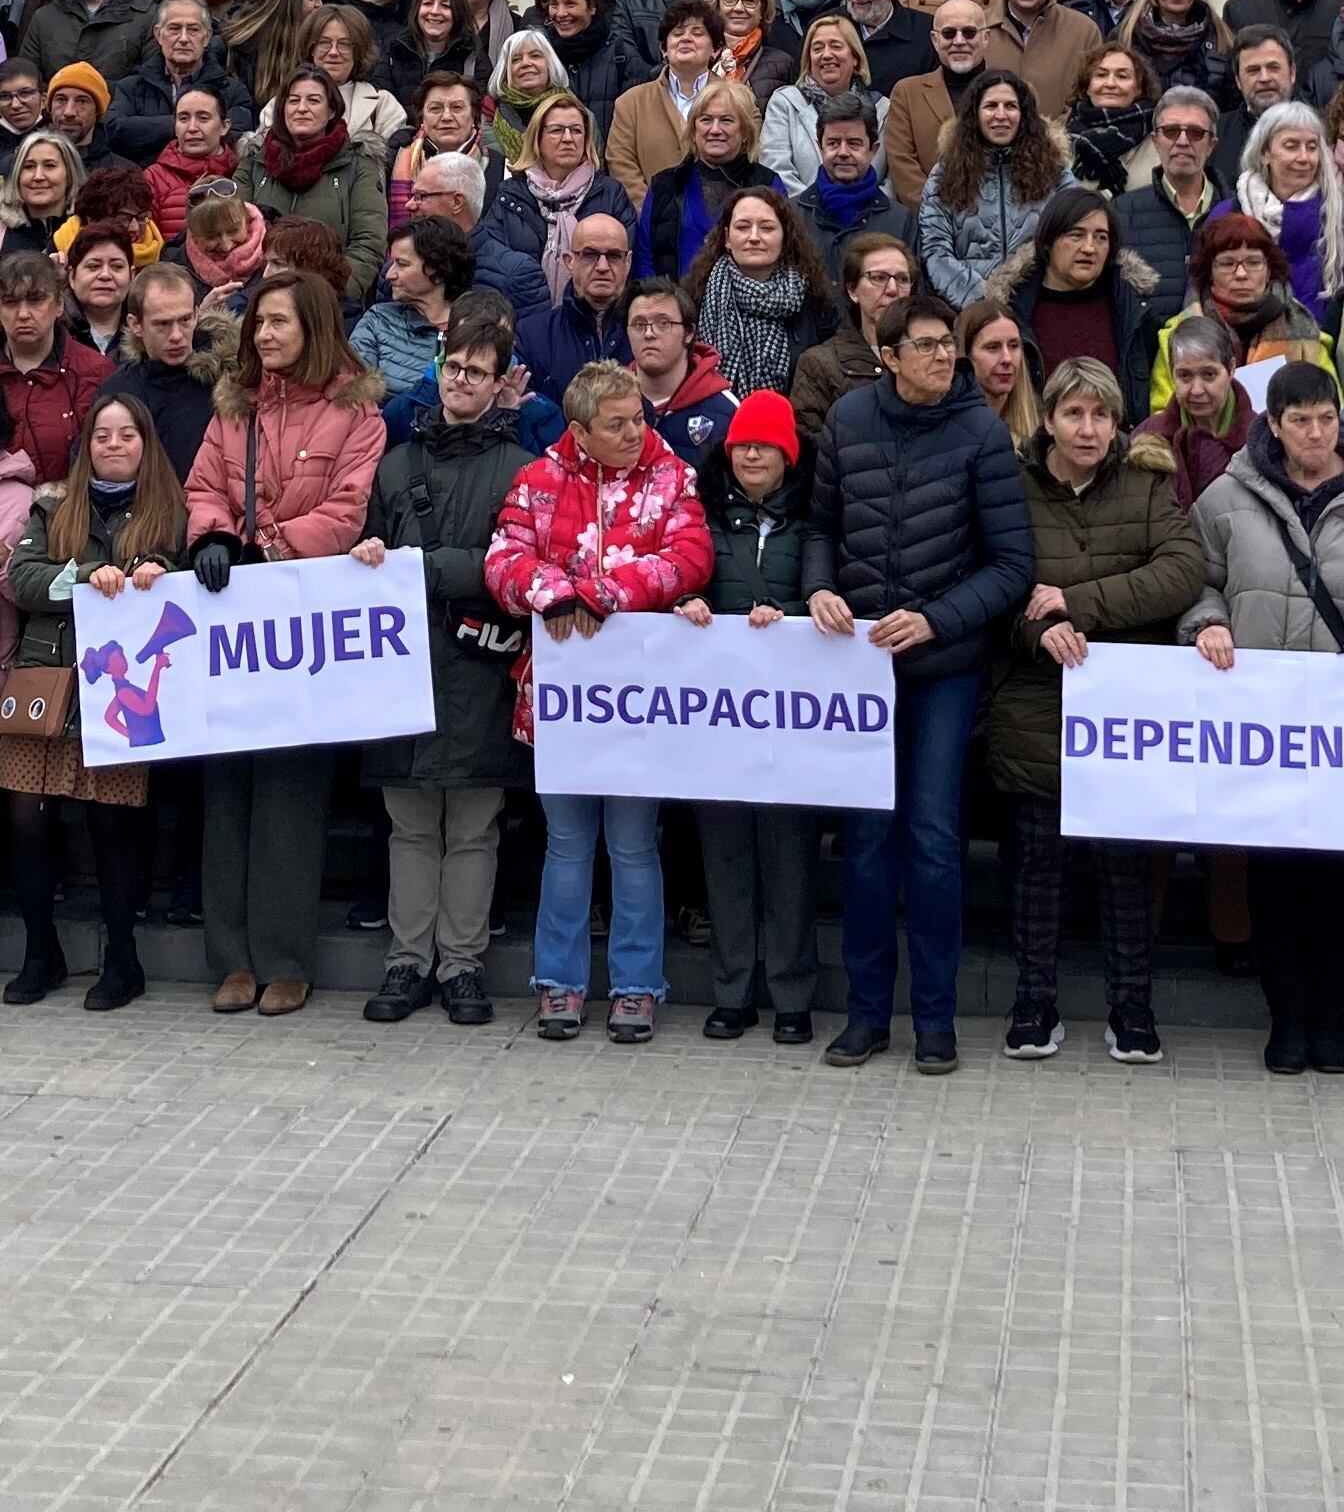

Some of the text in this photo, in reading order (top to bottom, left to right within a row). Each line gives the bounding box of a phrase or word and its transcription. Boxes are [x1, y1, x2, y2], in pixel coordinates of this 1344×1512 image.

[209, 605, 411, 677] MUJER
[457, 617, 522, 653] FILA
[538, 683, 888, 732] DISCAPACIDAD
